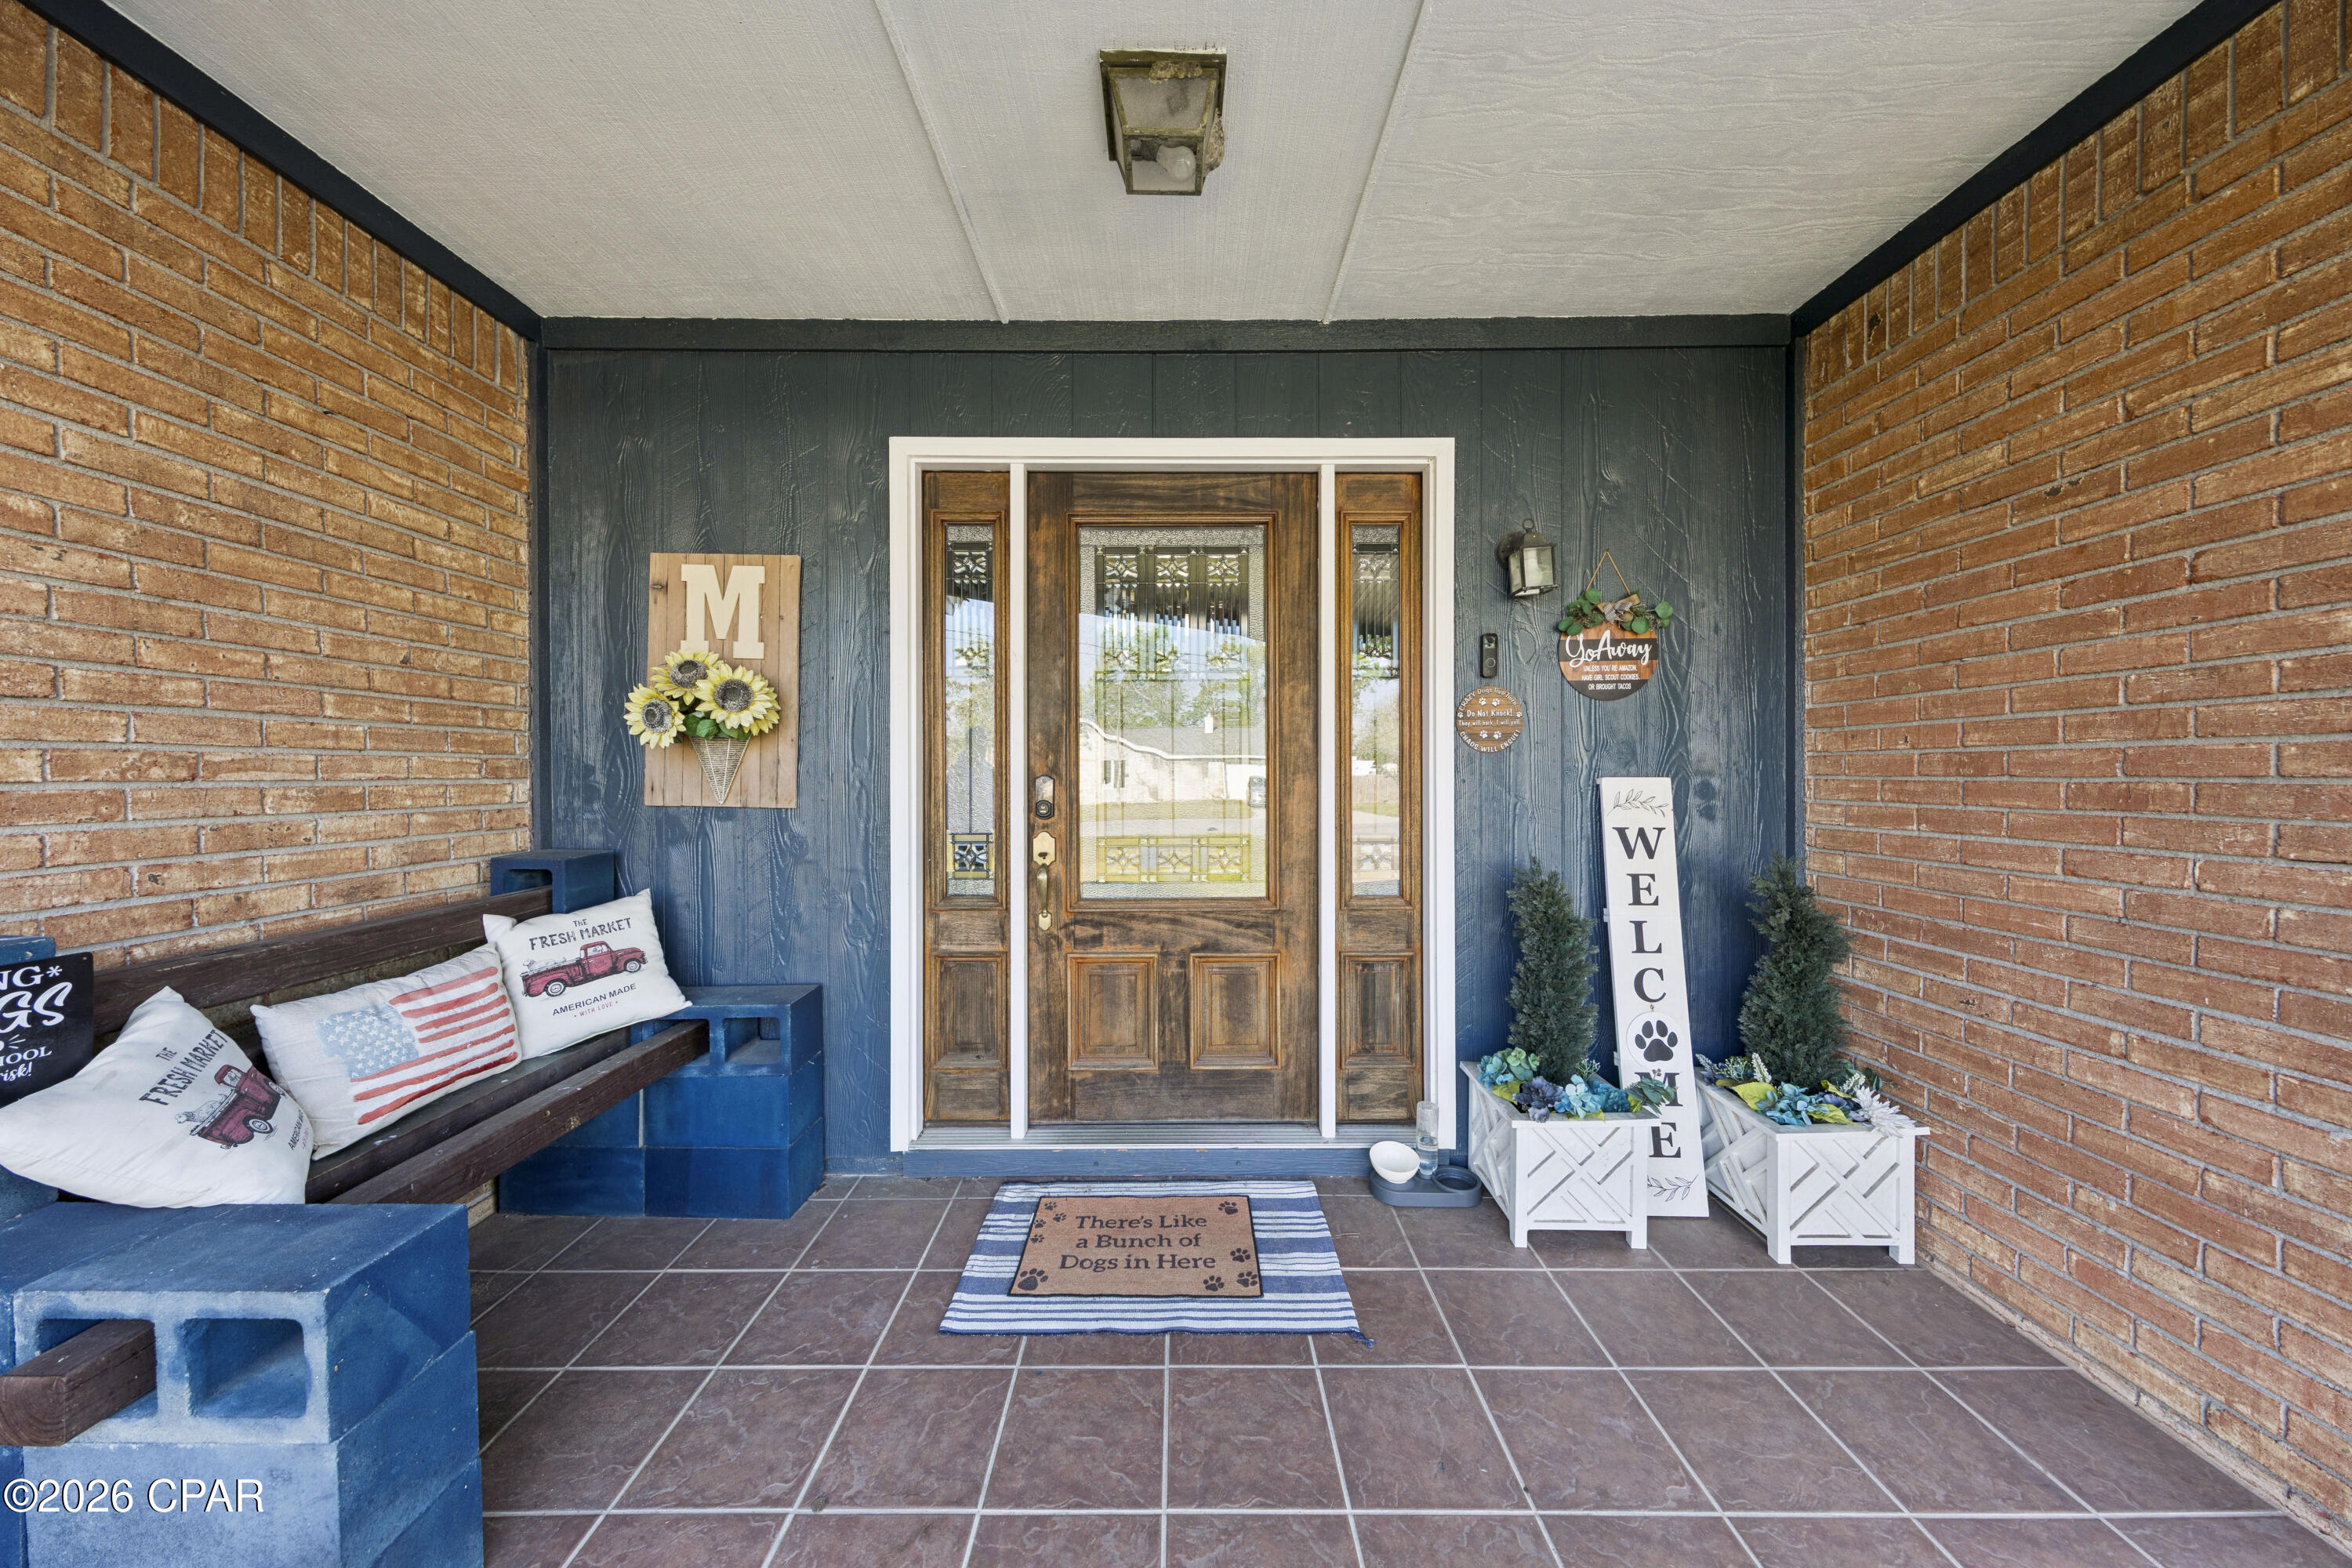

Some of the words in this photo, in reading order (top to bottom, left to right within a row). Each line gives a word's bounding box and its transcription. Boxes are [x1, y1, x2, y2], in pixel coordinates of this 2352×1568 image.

[681, 564, 765, 659] M
[1458, 691, 1475, 711] CRAZY
[1477, 709, 1489, 717] Not
[1491, 708, 1513, 717] Knock!
[1460, 731, 1479, 750] CHAOS
[1500, 729, 1521, 750] ENSUE!
[572, 918, 588, 927] THE
[528, 929, 576, 951] FRESH
[579, 917, 632, 940] MARKET
[552, 993, 607, 1016] AMERICAN
[608, 983, 637, 998] MADE
[579, 1007, 596, 1018] WITH
[597, 1002, 614, 1011] LOVE
[155, 1047, 178, 1062] THE
[138, 1066, 198, 1105] FRESH
[180, 1029, 228, 1073] MARKET
[1076, 1215, 1153, 1229] There's
[1159, 1214, 1207, 1229] Like
[1076, 1237, 1088, 1249] a
[1095, 1234, 1173, 1248] Bunch
[1178, 1232, 1201, 1247] of
[1059, 1254, 1119, 1273] Dogs
[1123, 1254, 1151, 1269] in
[1156, 1254, 1216, 1269] Here
